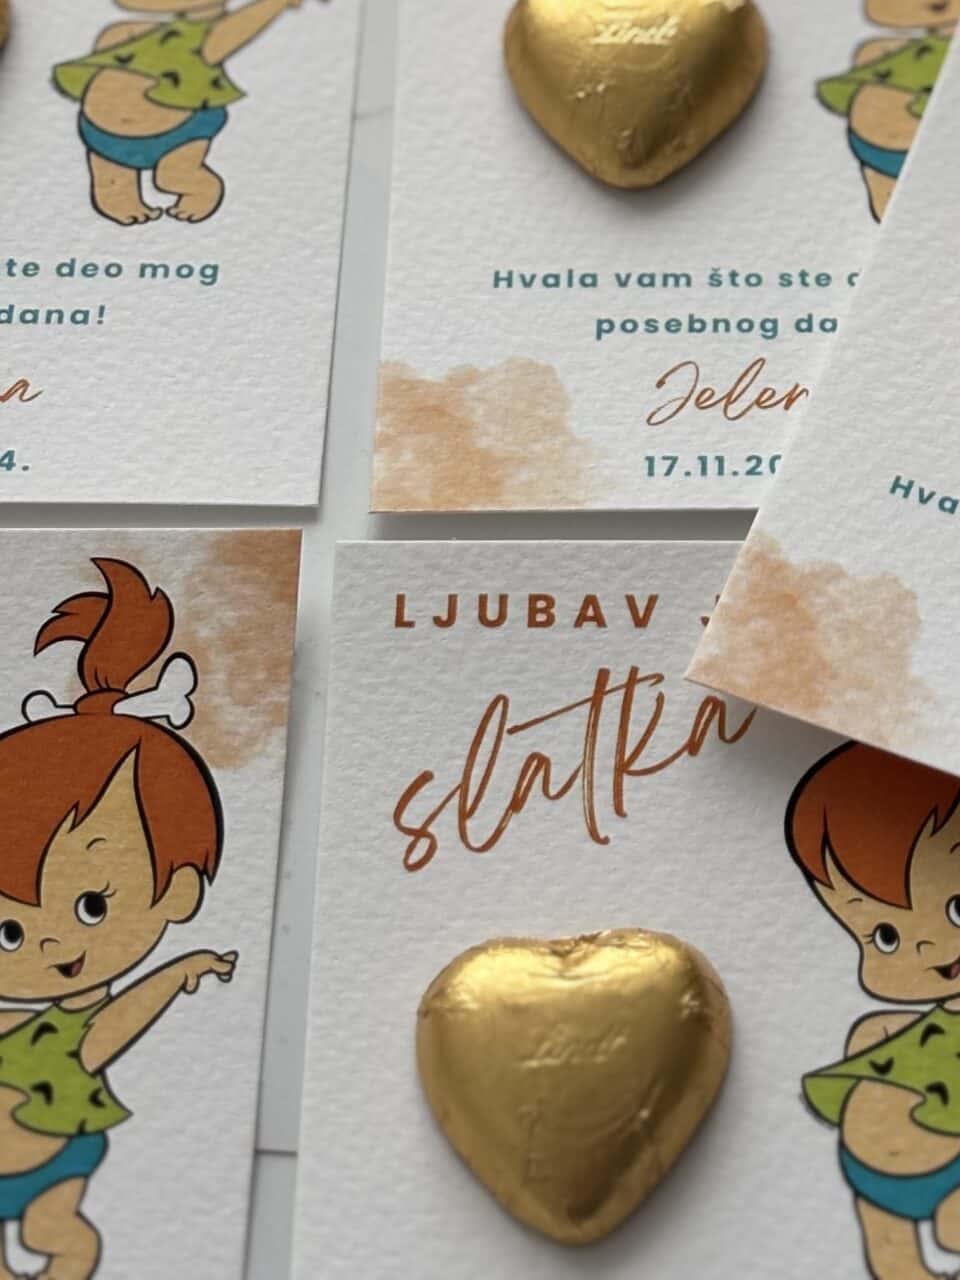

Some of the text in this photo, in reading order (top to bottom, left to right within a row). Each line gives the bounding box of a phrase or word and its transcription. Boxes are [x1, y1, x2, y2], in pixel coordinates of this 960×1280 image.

[55, 257, 124, 279] deo
[138, 262, 220, 287] mog
[492, 267, 833, 289] Hvala vam što ste
[0, 303, 106, 326] dana!
[595, 313, 779, 341] posebnog
[393, 593, 660, 630] LJUBAV
[392, 664, 758, 873] slatka
